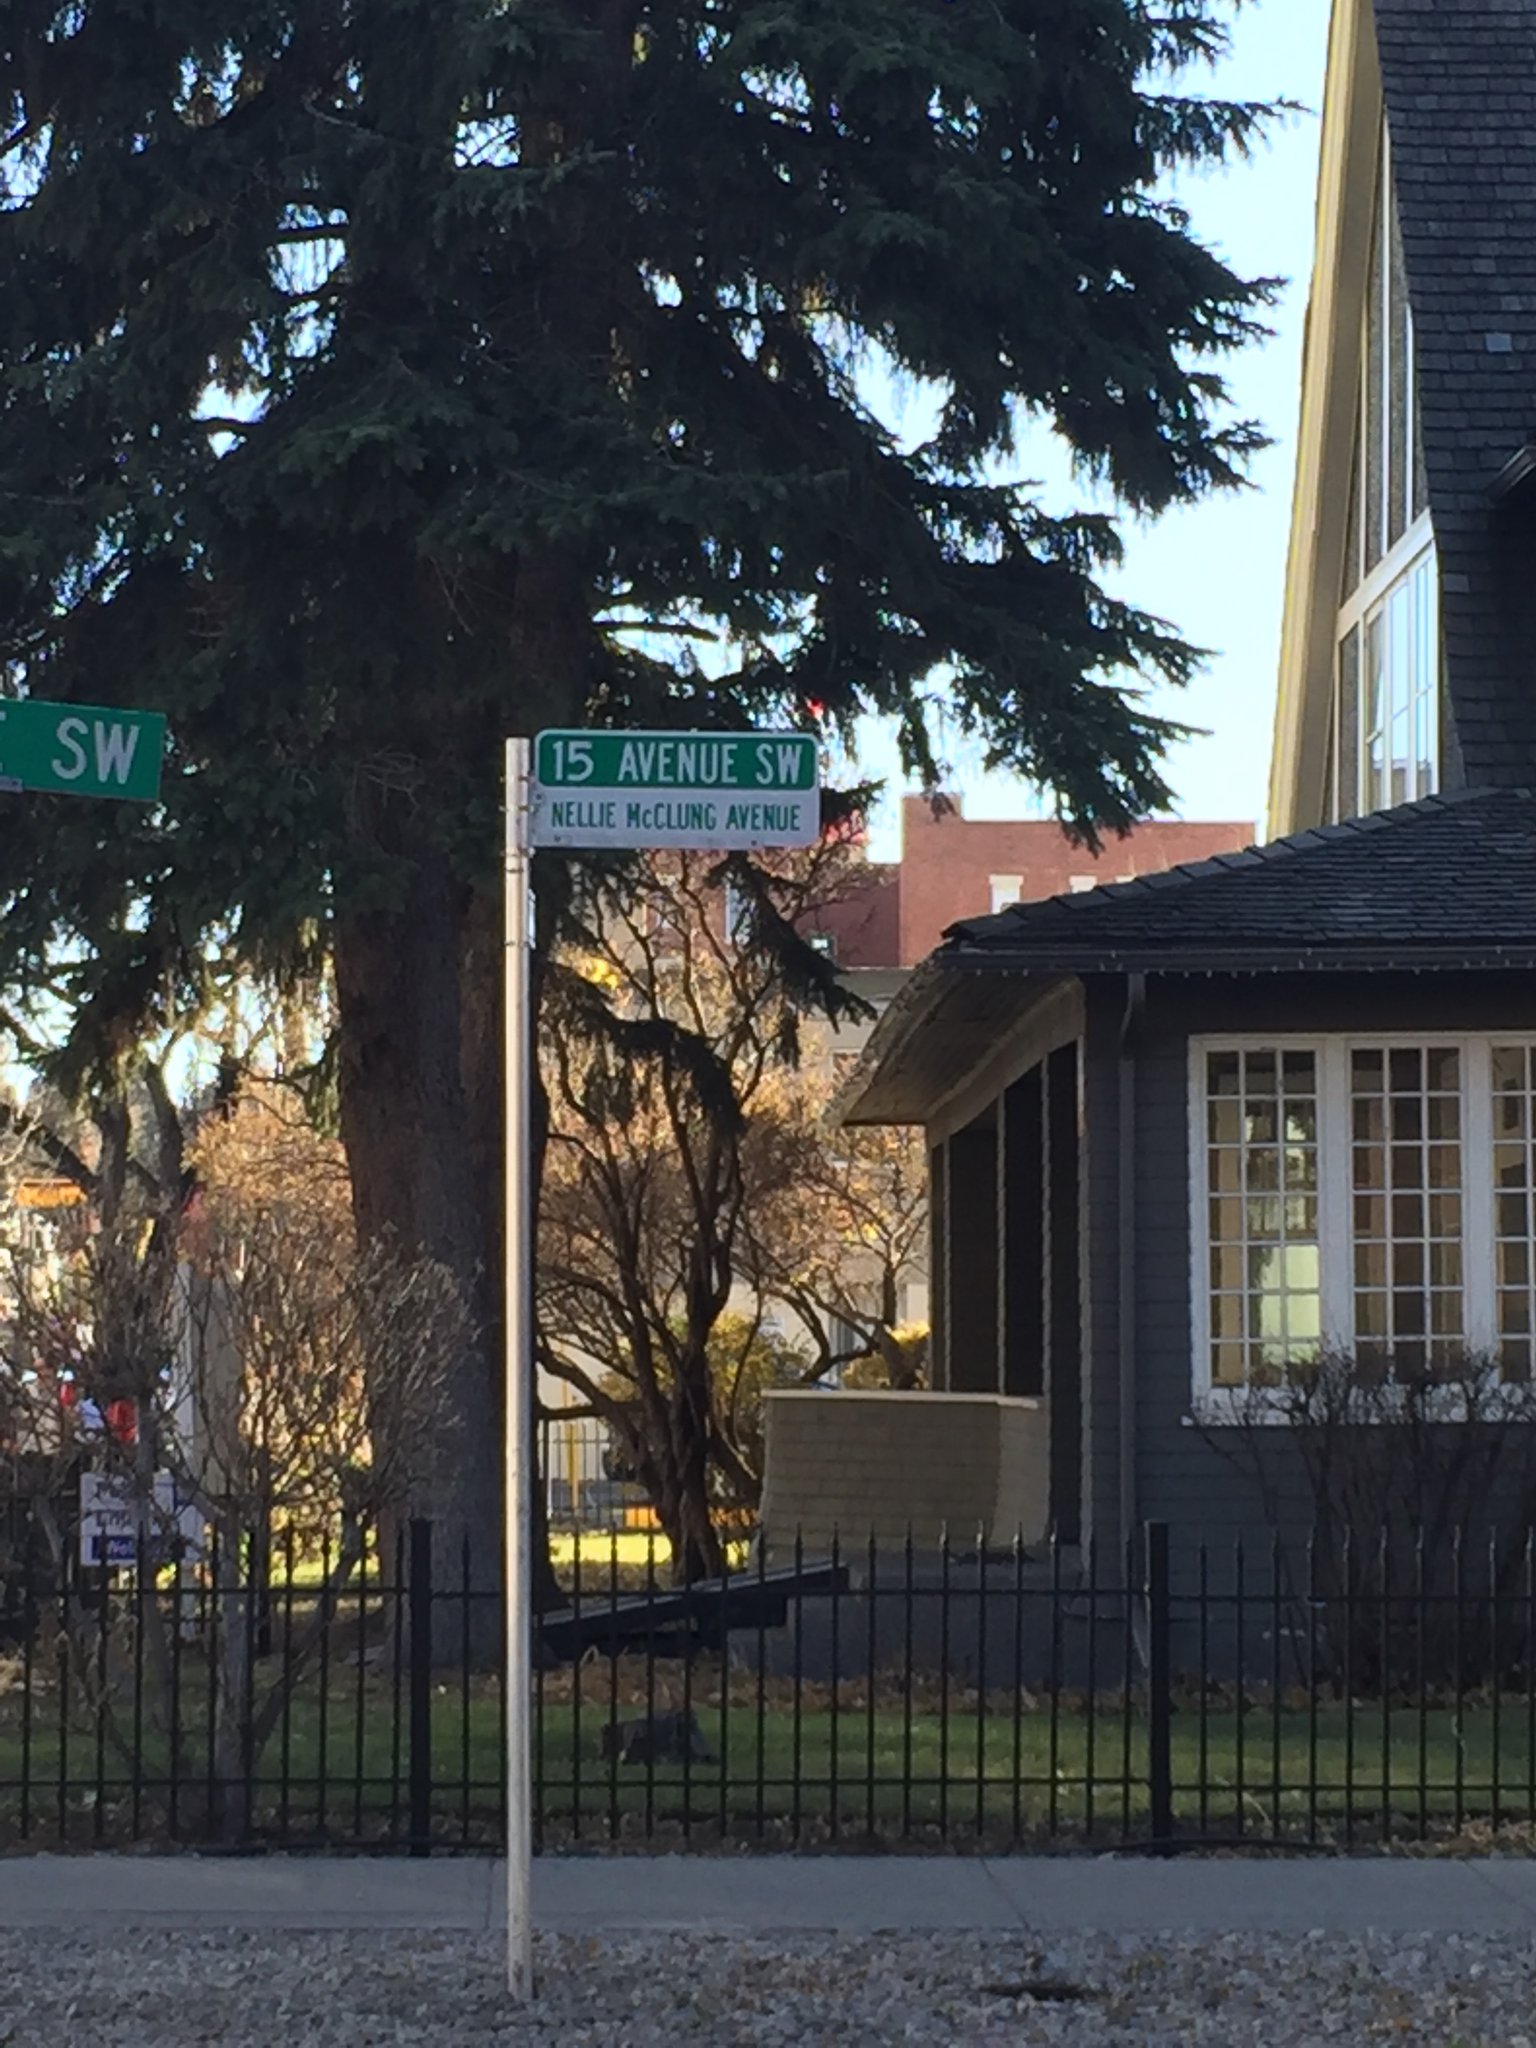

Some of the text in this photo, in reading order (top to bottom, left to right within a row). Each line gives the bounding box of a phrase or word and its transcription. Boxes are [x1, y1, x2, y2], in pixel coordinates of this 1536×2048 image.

[52, 717, 141, 785] SW
[552, 740, 802, 785] 15 AVENUE SW
[551, 801, 802, 832] NELLIE McCLUNG AVENUE
